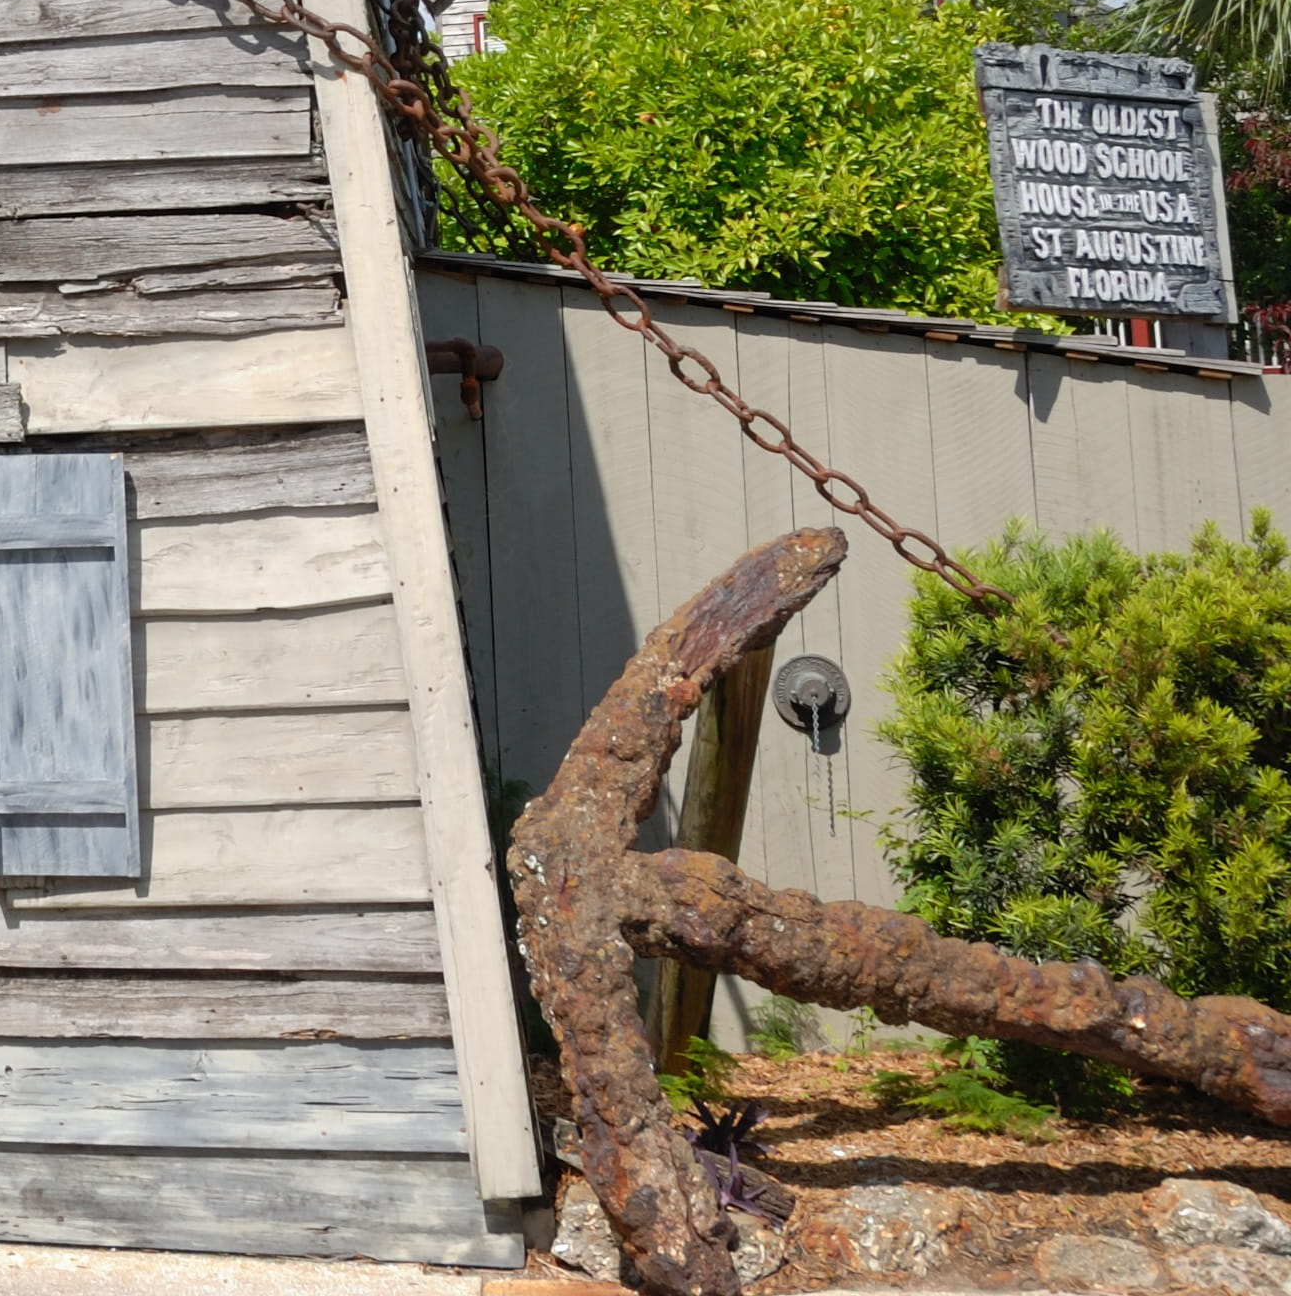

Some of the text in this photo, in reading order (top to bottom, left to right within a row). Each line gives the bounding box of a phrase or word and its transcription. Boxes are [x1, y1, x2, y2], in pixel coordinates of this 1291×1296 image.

[1035, 98, 1179, 140] THE OLDEST
[1010, 138, 1189, 182] WOOD SCHOOL
[1020, 181, 1099, 218] HOUSE
[1118, 194, 1141, 213] THE
[1031, 226, 1205, 267] ST AUGUSTINE
[1067, 267, 1174, 302] FLORIDA
